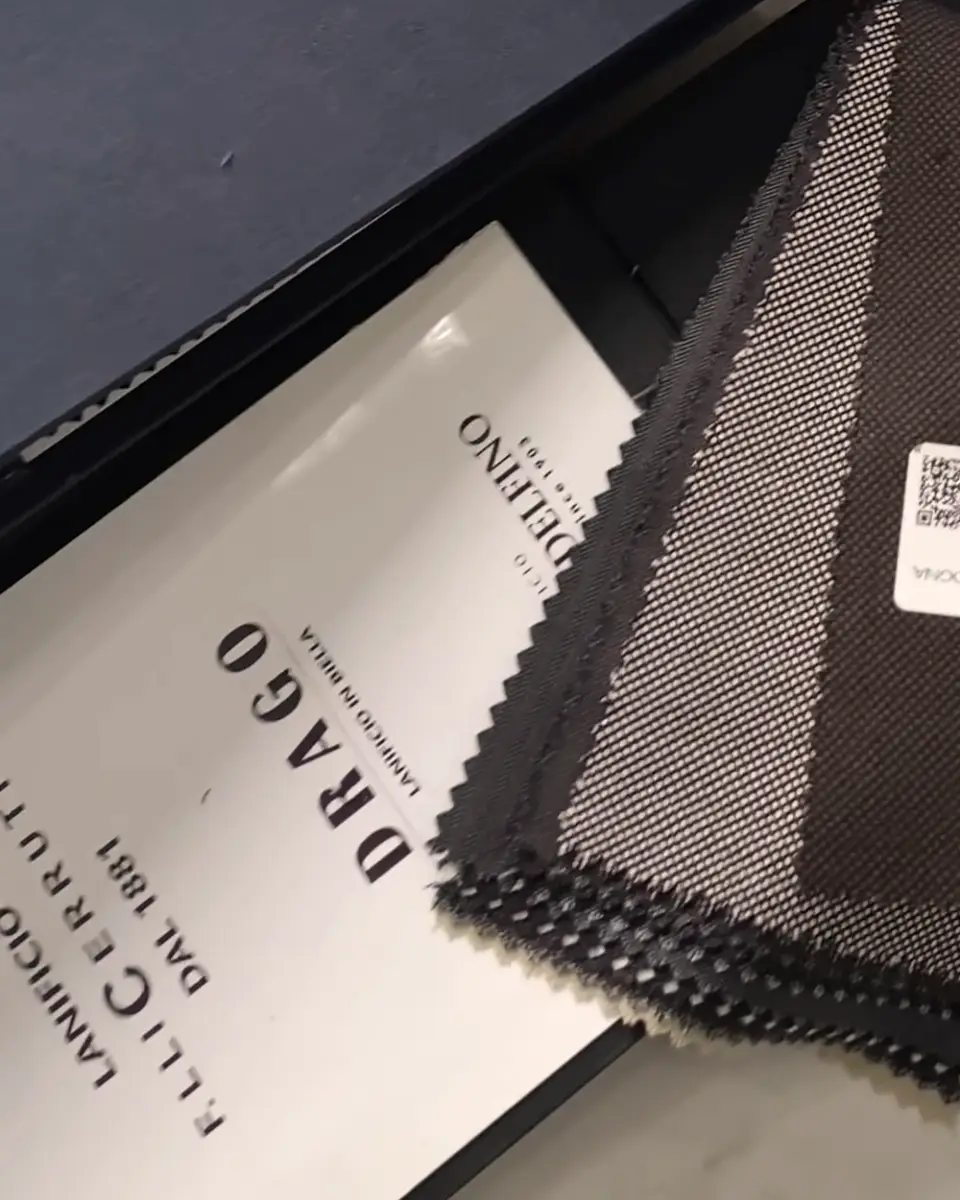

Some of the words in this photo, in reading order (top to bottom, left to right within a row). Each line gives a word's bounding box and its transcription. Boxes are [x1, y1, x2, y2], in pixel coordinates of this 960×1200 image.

[458, 413, 578, 567] DELFINO
[555, 482, 587, 524] ince
[300, 624, 344, 686] BIELLA
[339, 685, 360, 710] IN
[217, 621, 413, 884] DRAGO
[356, 709, 421, 798] LANIFICIO
[96, 835, 157, 919] 1881
[0, 905, 118, 1090] LANIFICIO
[154, 915, 209, 998] DAL
